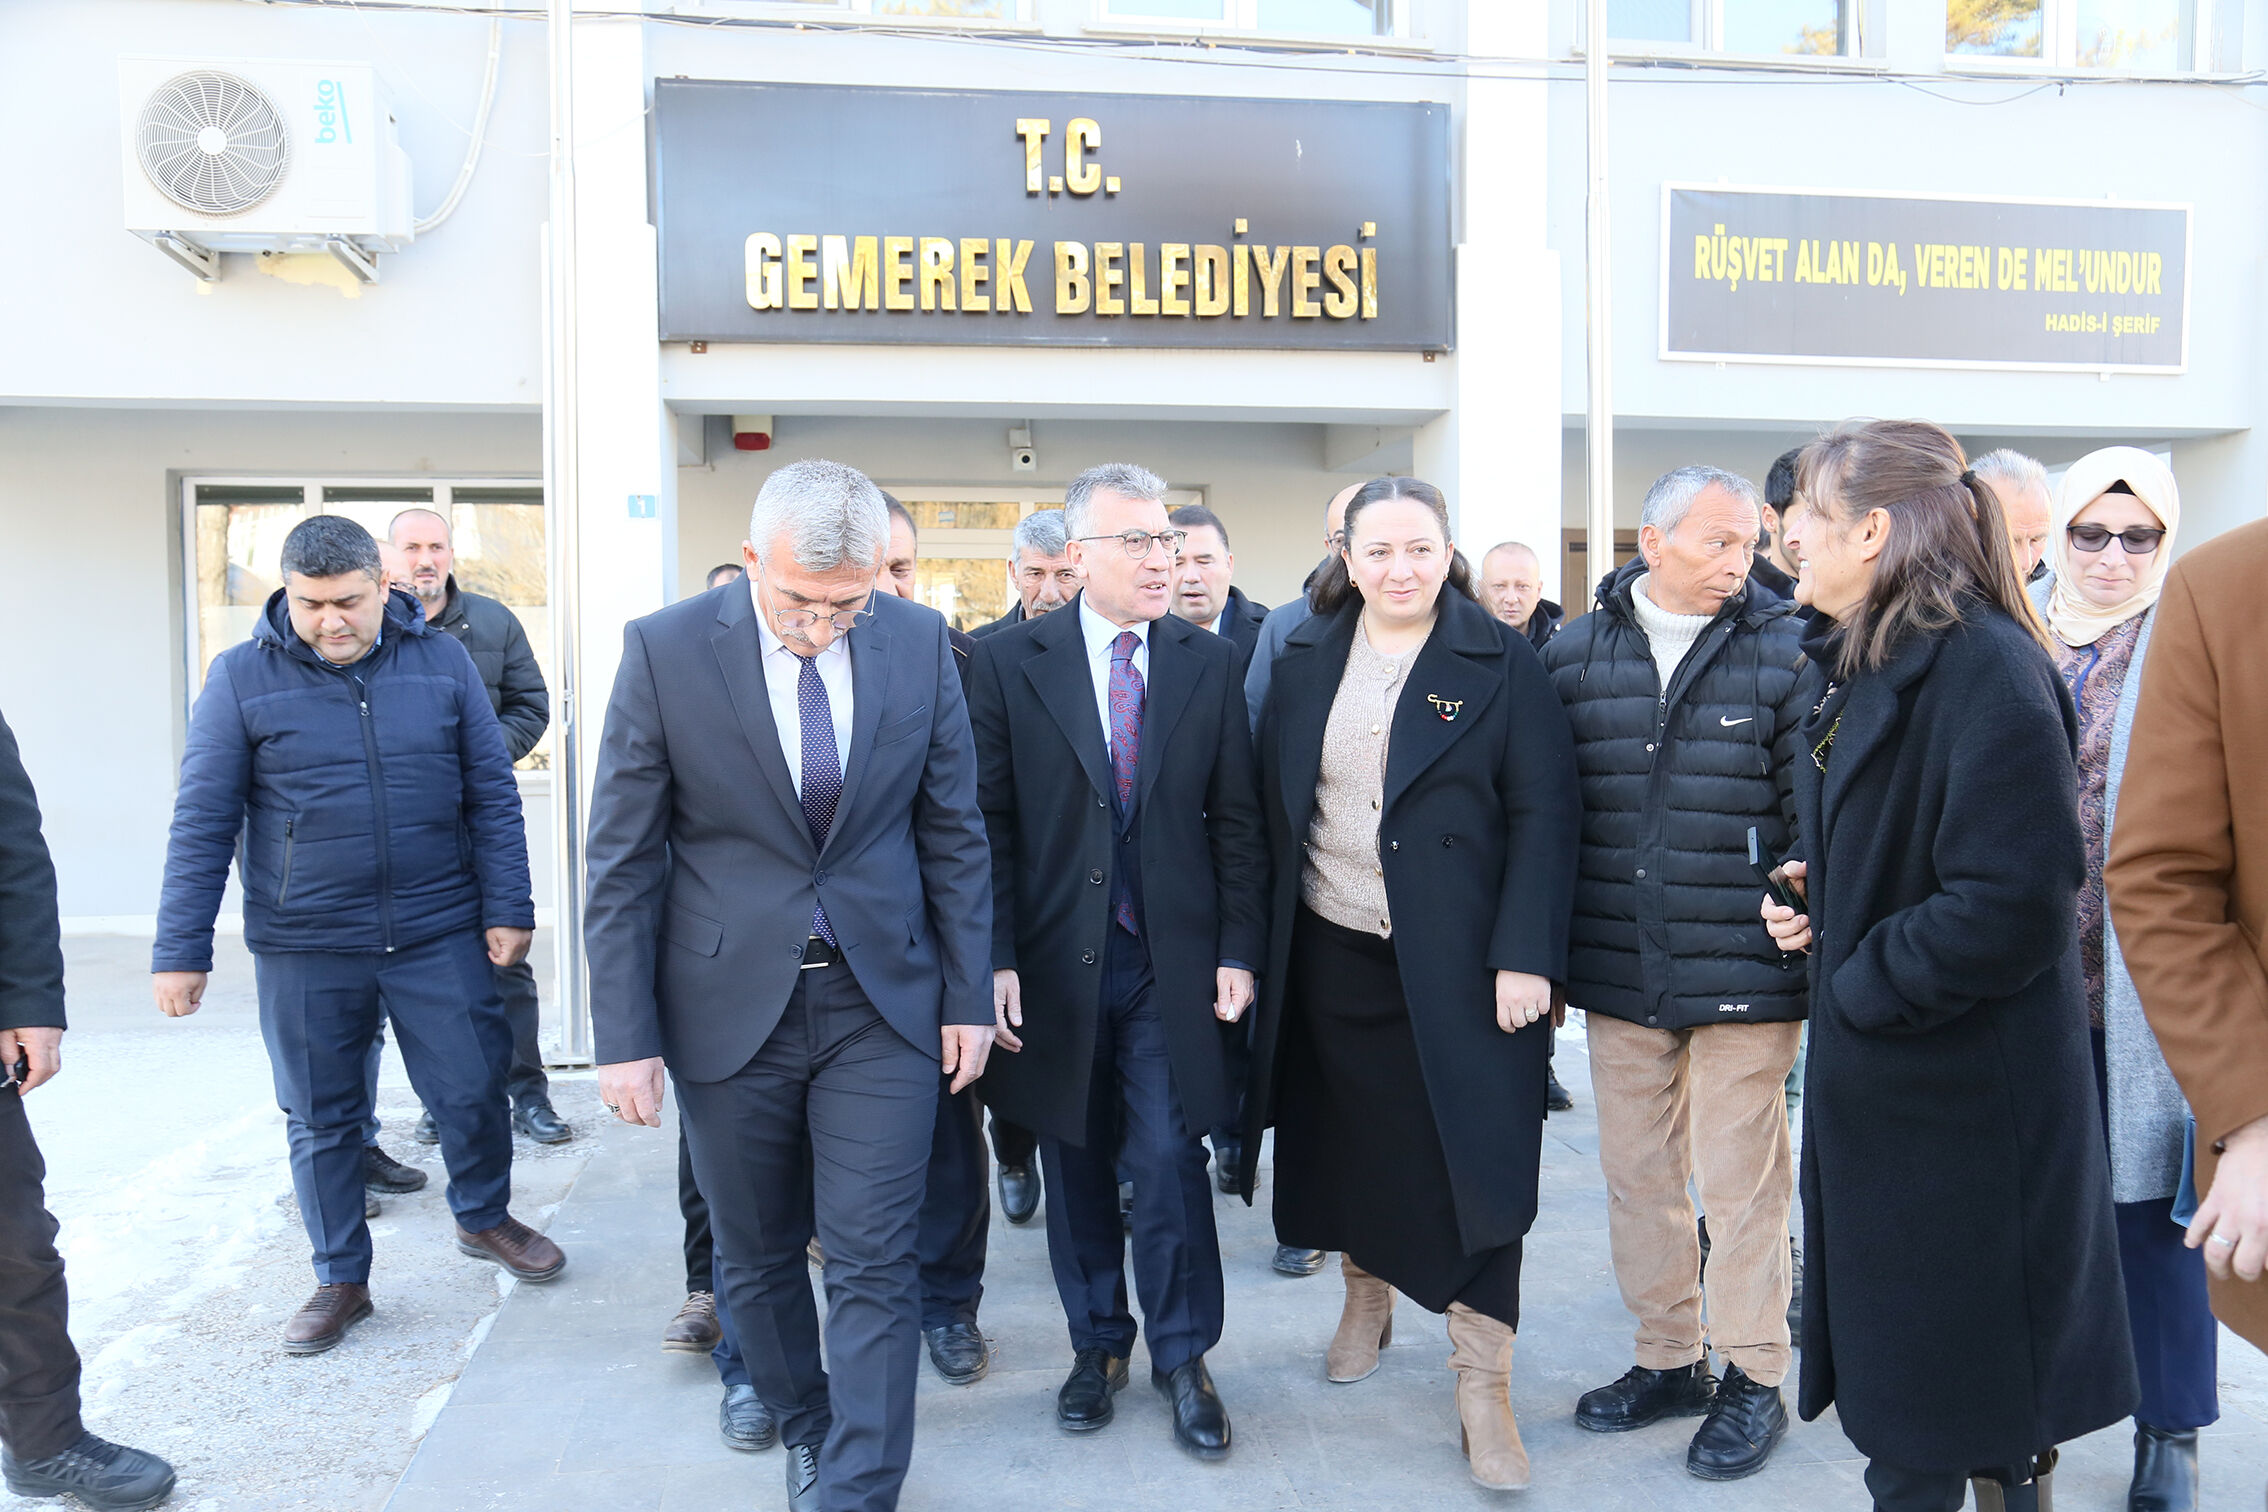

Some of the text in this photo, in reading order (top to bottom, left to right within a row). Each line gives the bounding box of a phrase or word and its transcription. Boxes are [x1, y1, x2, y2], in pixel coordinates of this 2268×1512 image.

[313, 79, 335, 144] beko
[1015, 116, 1122, 195] T.C.
[743, 217, 1378, 320] GEMEREK BELEDİYESİ
[1694, 223, 2162, 296] RÜŞVET ALAN DA, VEREN DE MEL'UNDUR
[2044, 310, 2161, 338] HADİS-İ ŞERİF
[636, 498, 646, 515] 1
[1718, 1003, 1750, 1013] DRI-FIT
